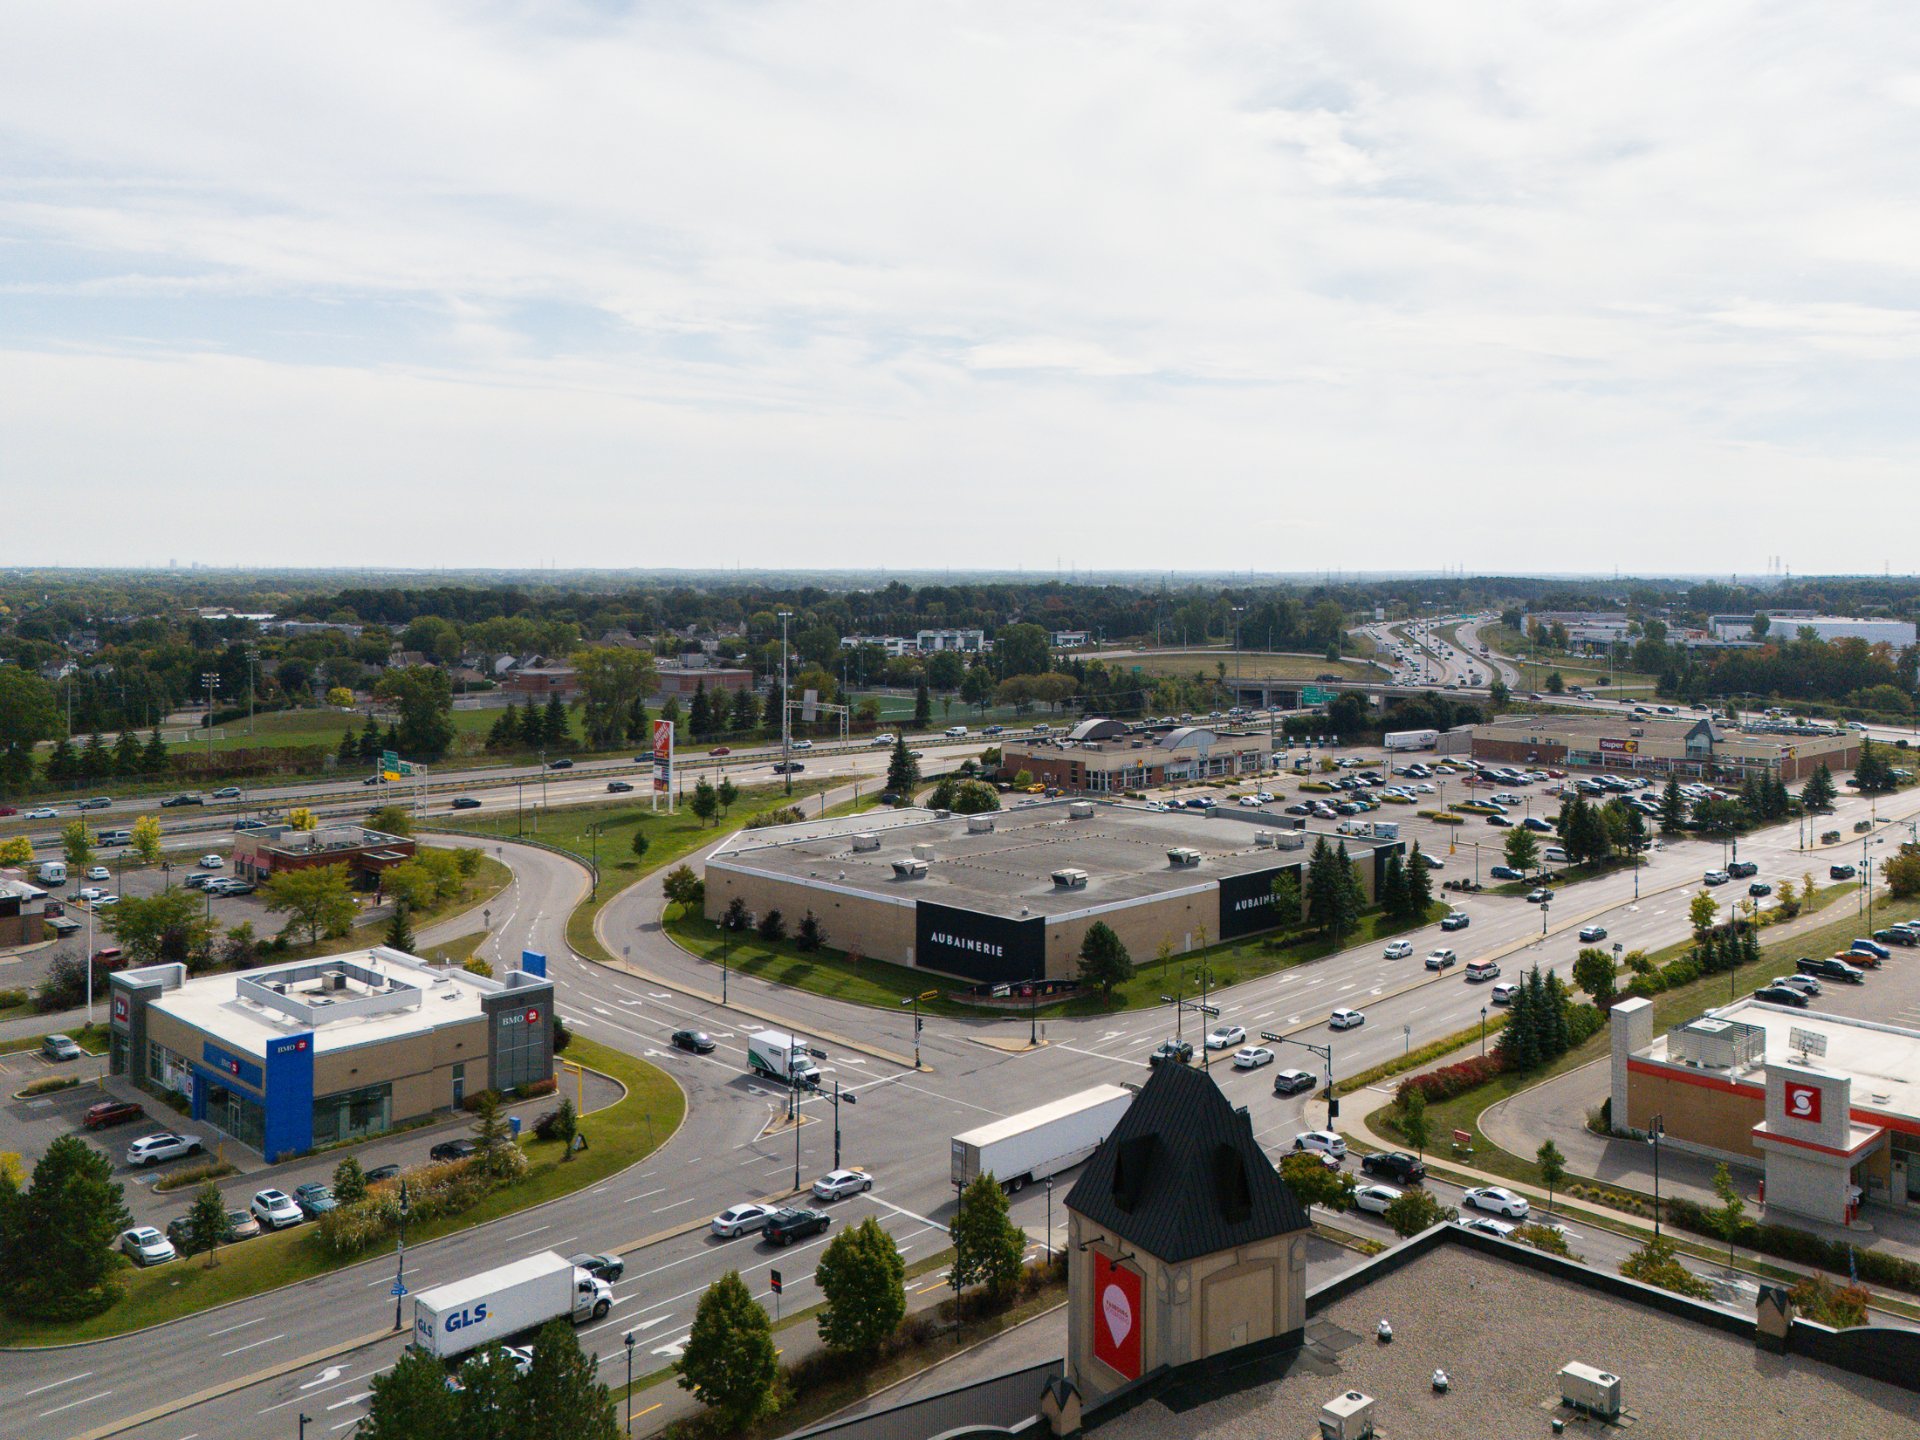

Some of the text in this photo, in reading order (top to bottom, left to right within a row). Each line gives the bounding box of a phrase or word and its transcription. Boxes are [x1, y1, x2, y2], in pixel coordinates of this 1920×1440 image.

[1601, 741, 1625, 750] Super
[931, 931, 1004, 957] AUBAINERIE
[502, 1014, 524, 1027] BMO
[277, 1044, 296, 1054] BMO
[417, 1318, 433, 1338] GLS
